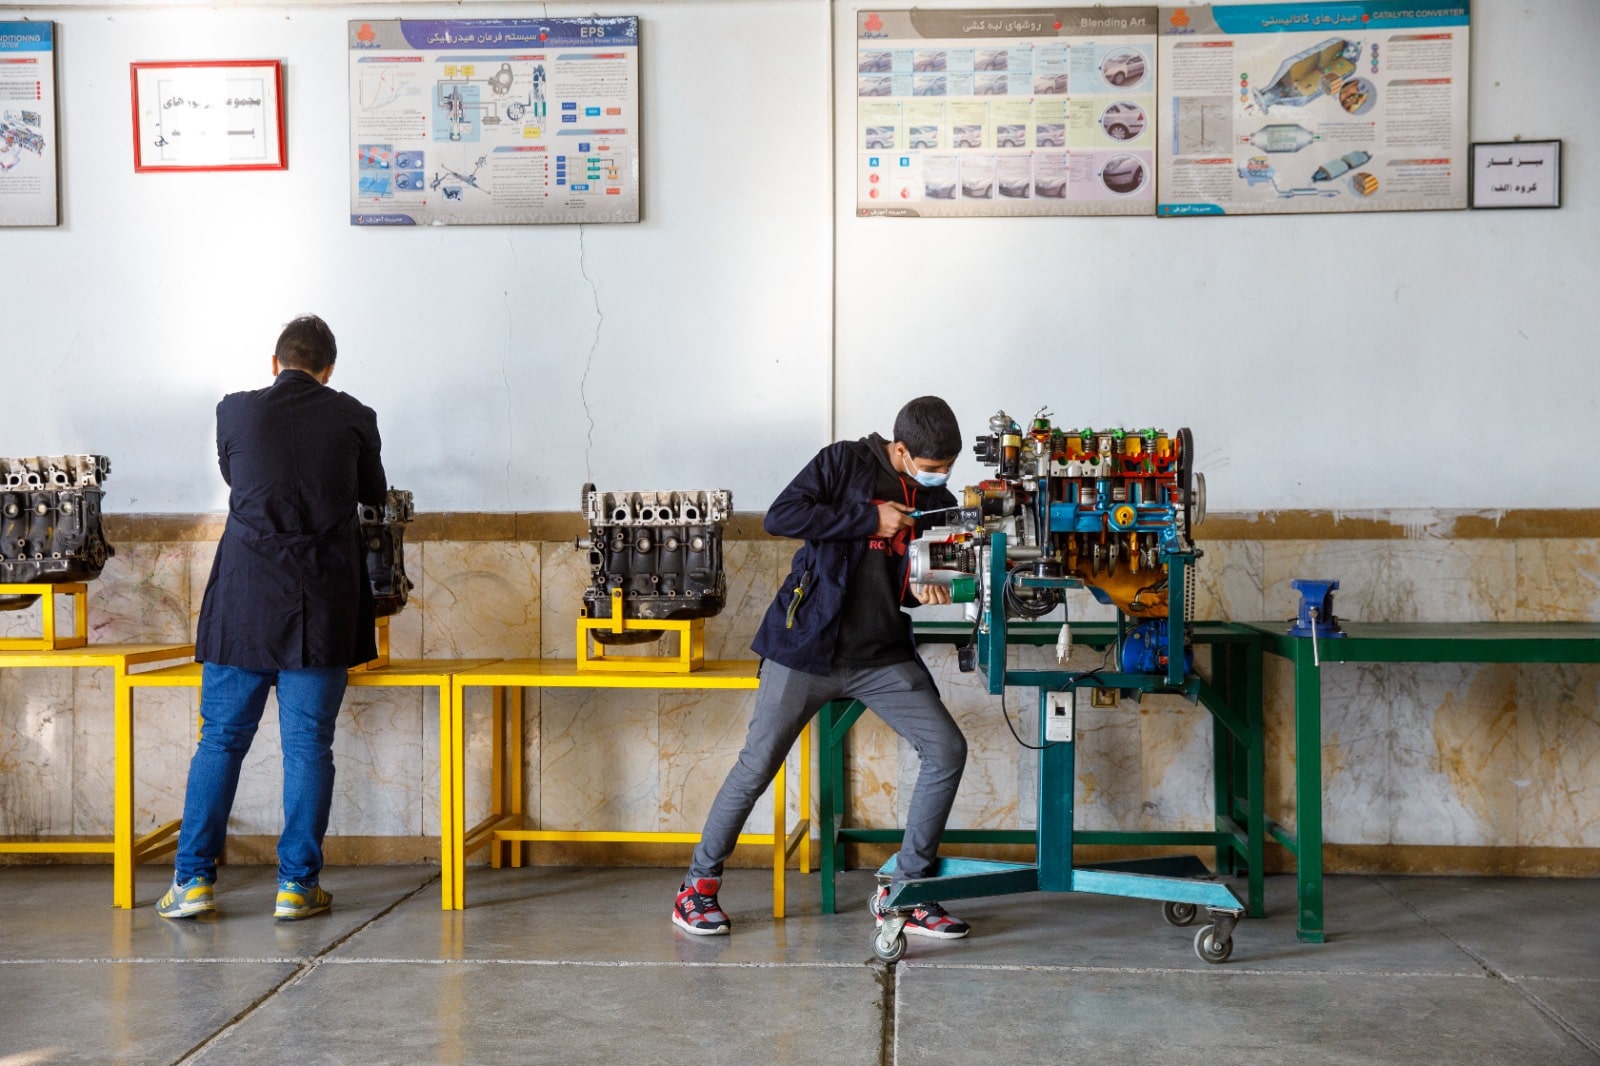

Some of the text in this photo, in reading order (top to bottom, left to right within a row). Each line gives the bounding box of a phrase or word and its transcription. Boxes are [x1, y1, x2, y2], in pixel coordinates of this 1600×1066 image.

[1373, 8, 1465, 19] CATALYTIC CONVERTER
[1080, 16, 1146, 28] Blending Art
[477, 32, 503, 44] فرمان
[505, 33, 537, 43] سیستم
[580, 26, 605, 38] EPS
